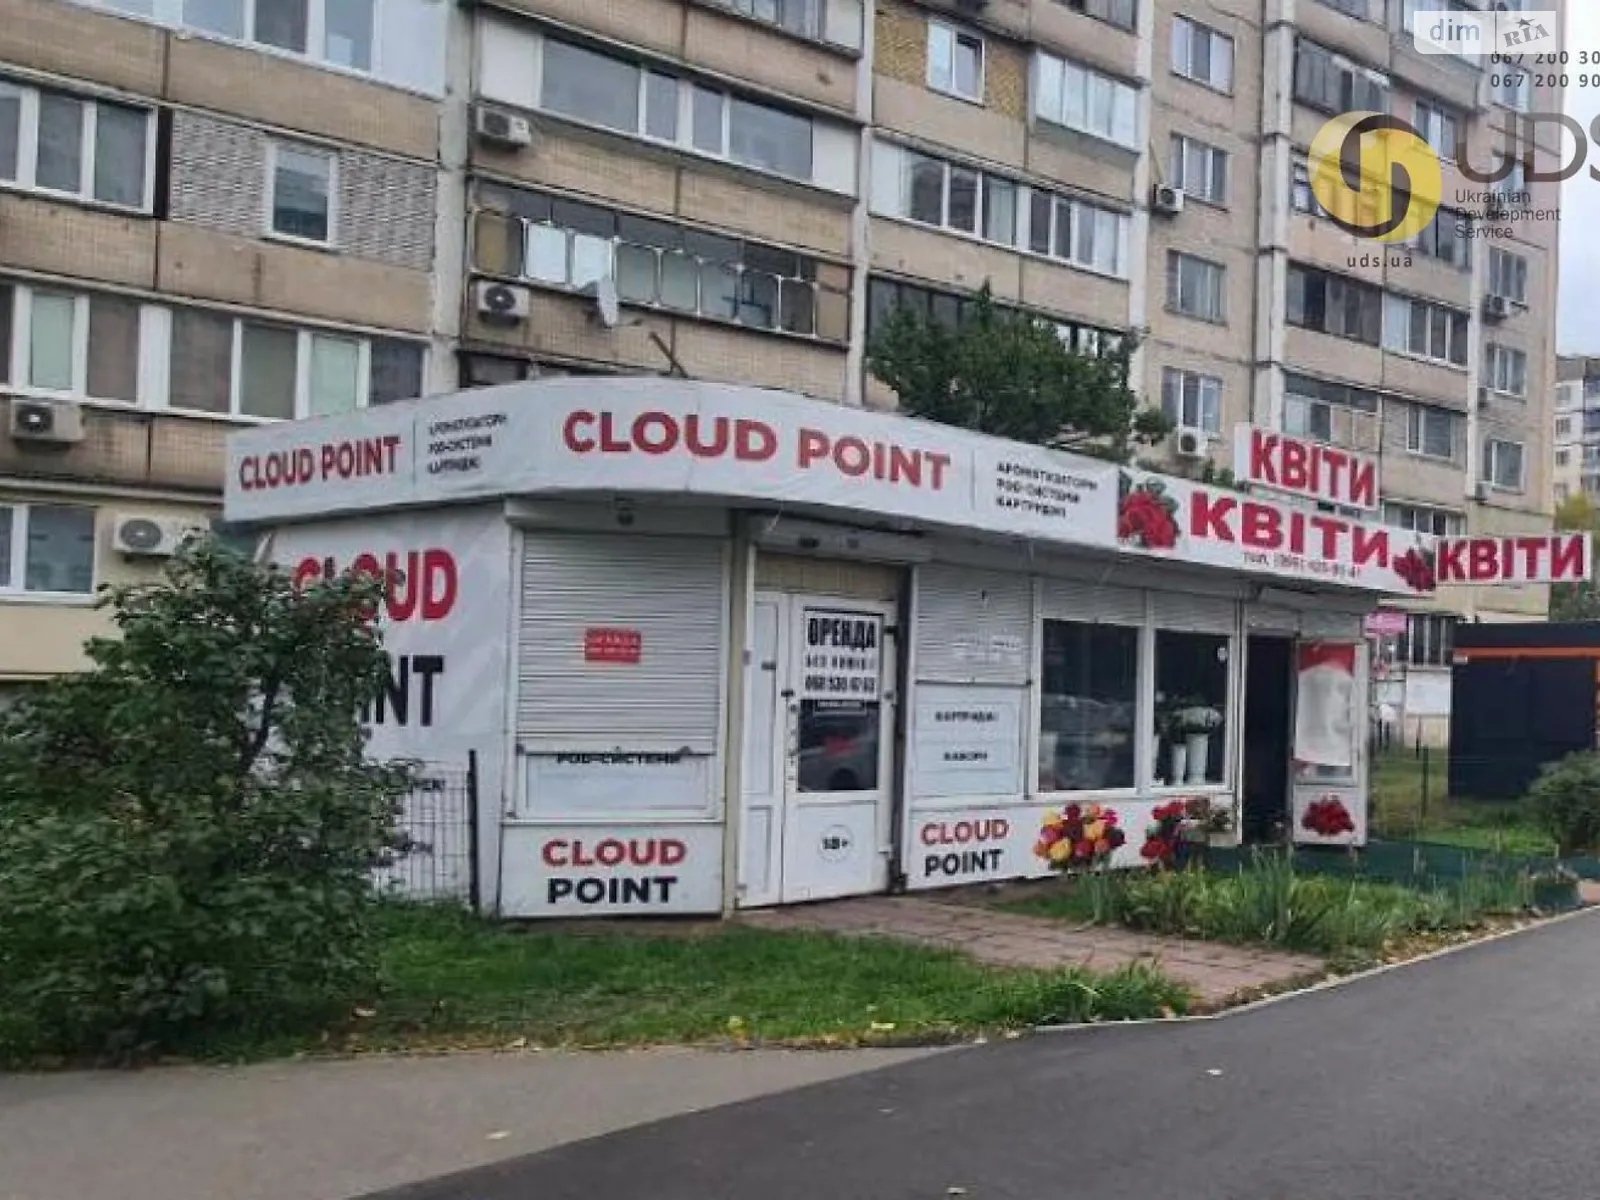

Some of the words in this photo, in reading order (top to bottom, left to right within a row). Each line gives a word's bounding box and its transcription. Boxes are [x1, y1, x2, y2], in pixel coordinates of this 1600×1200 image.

[239, 447, 314, 492] CLOUD
[322, 435, 401, 481] POINT
[563, 409, 778, 462] CLOUD
[798, 427, 952, 490] POINT
[1250, 428, 1376, 507] КВІТИ
[1190, 491, 1389, 569] КВІТИ
[1436, 533, 1586, 583] КВІТИ
[807, 617, 876, 652] ОРЕНДА
[543, 838, 687, 868] CLOUD
[921, 819, 1010, 848] CLOUD
[924, 848, 1004, 877] POINT
[548, 876, 677, 905] POINT
